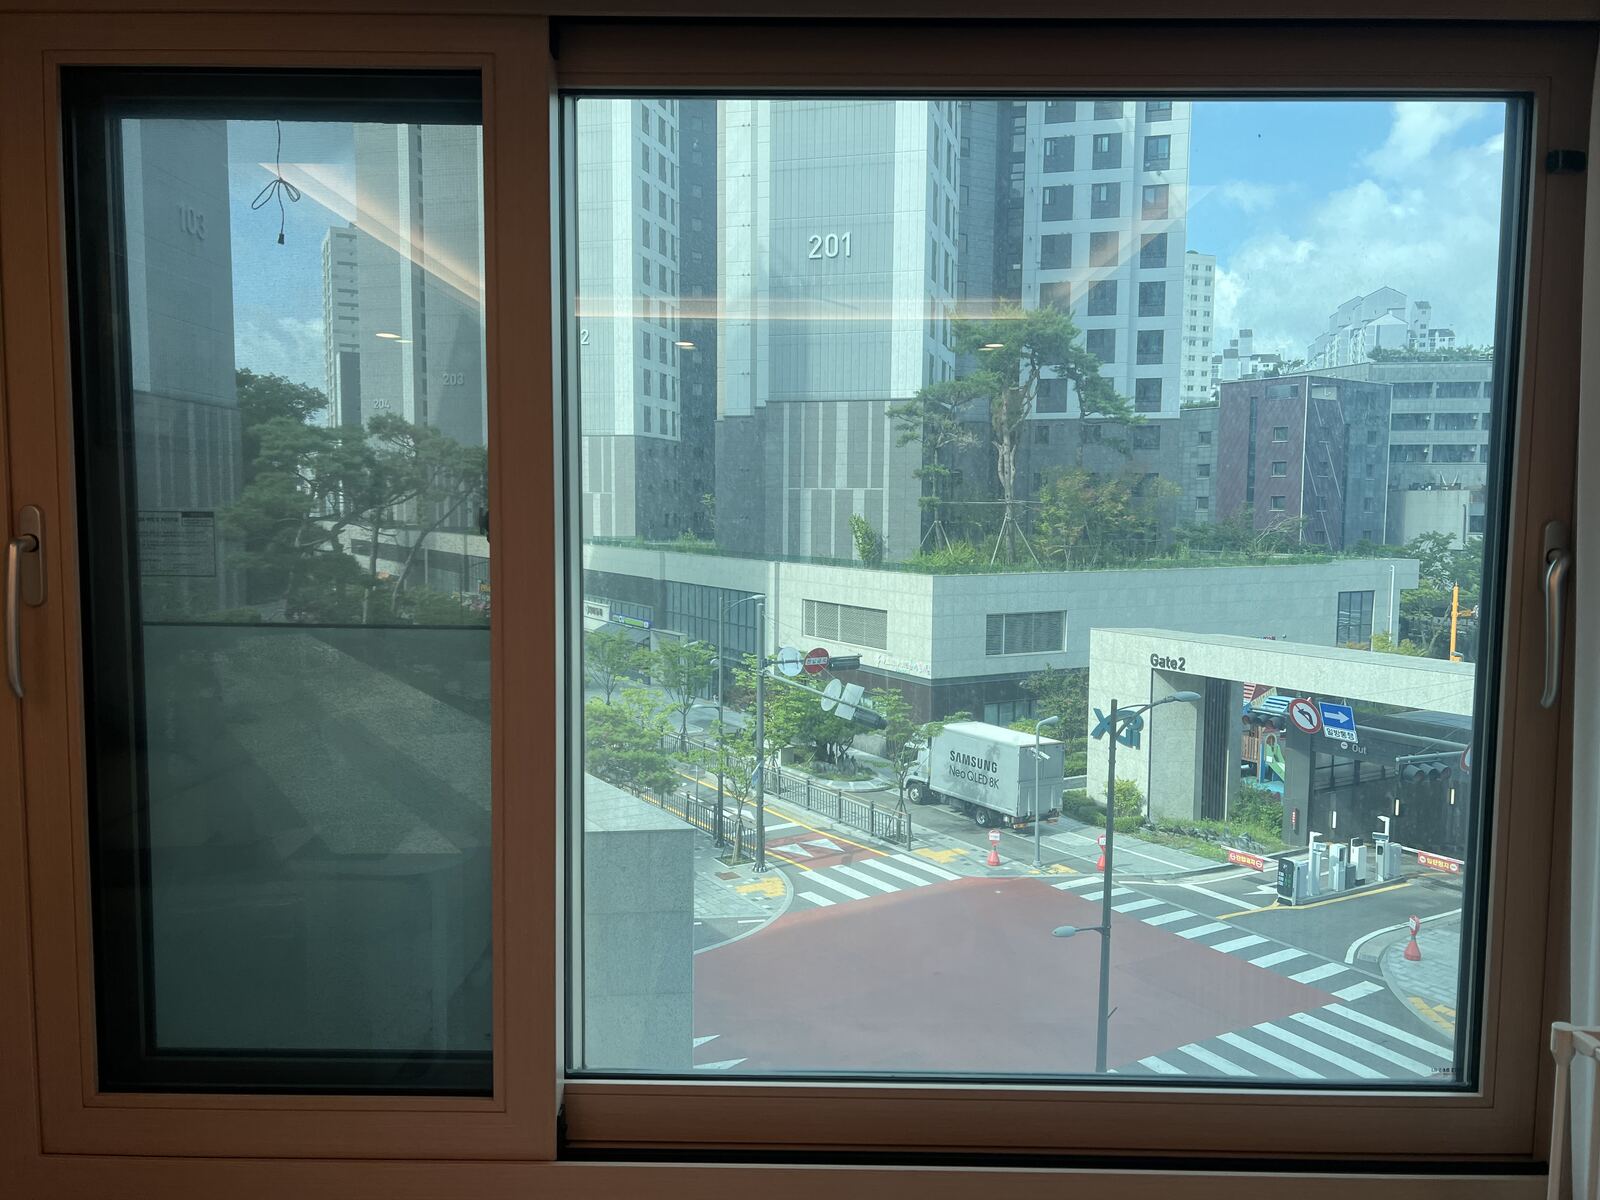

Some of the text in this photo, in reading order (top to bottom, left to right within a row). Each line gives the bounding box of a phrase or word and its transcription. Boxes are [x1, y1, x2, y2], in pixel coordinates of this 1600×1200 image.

[808, 231, 851, 259] 201
[441, 371, 465, 386] 203
[373, 399, 391, 410] 204
[1150, 653, 1186, 671] Gate2
[1326, 727, 1355, 741] 일방통행
[1351, 743, 1367, 755] Out
[949, 750, 998, 773] SAMSUNG
[949, 765, 1000, 789] Neo QLED 8K
